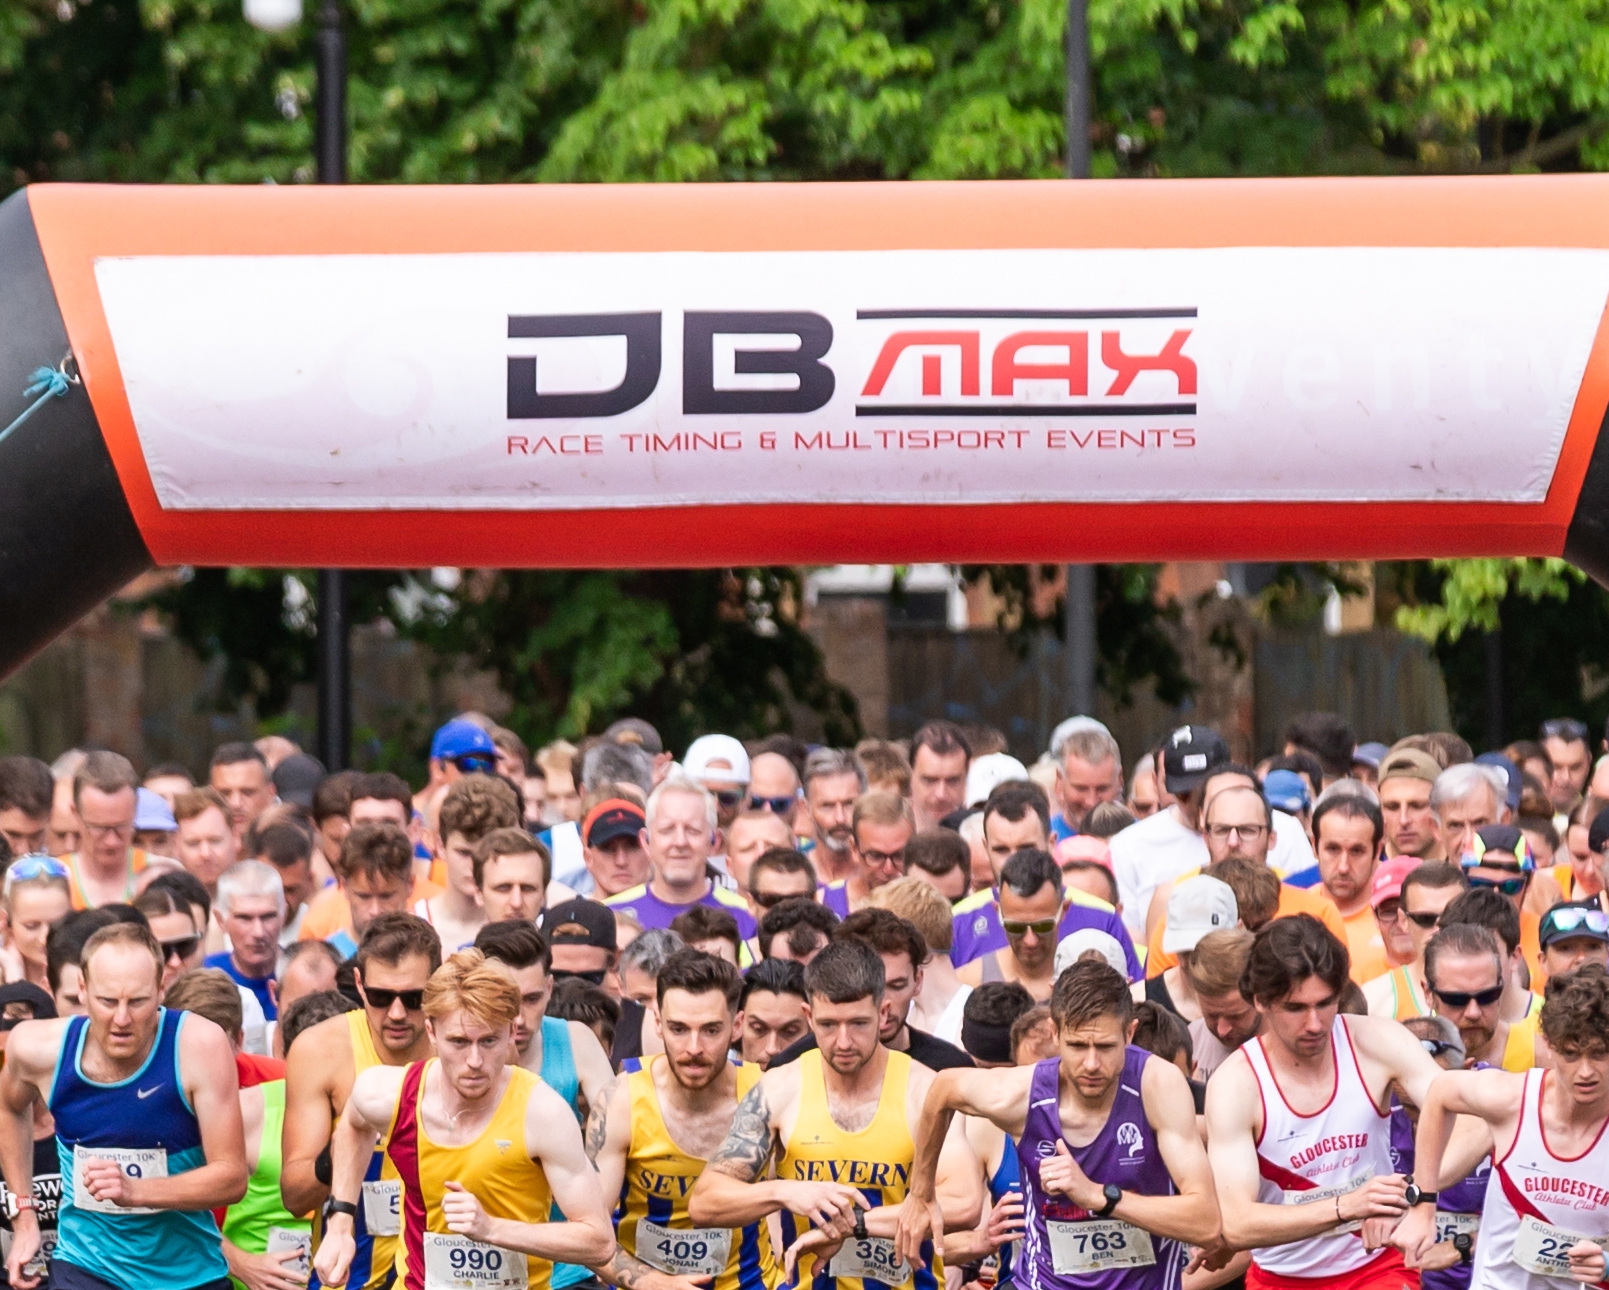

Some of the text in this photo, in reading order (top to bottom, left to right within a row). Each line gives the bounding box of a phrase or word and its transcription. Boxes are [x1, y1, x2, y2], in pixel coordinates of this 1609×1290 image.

[507, 310, 835, 419] DB
[860, 329, 1197, 396] MAX
[507, 428, 1196, 455] RACE TIMING & MULTISPORT EVENTS
[136, 1153, 156, 1162] 10K
[1290, 1133, 1369, 1170] GLOUCESTER
[641, 1169, 699, 1198] SEV
[1294, 1174, 1368, 1204] Gloucester 10K
[646, 1224, 723, 1240] Gloucester 10K
[1057, 1222, 1113, 1234] Gloucester
[1531, 1221, 1581, 1243] Gloucest
[657, 1239, 708, 1260] 409
[1073, 1231, 1127, 1254] 763
[450, 1248, 502, 1271] 990
[663, 1258, 699, 1268] JONAH
[856, 1240, 903, 1270] 356
[1092, 1252, 1115, 1261] BEN
[1535, 1256, 1572, 1268] ANTHO
[453, 1269, 500, 1280] CHARLIE
[863, 1260, 896, 1277] SIMON
